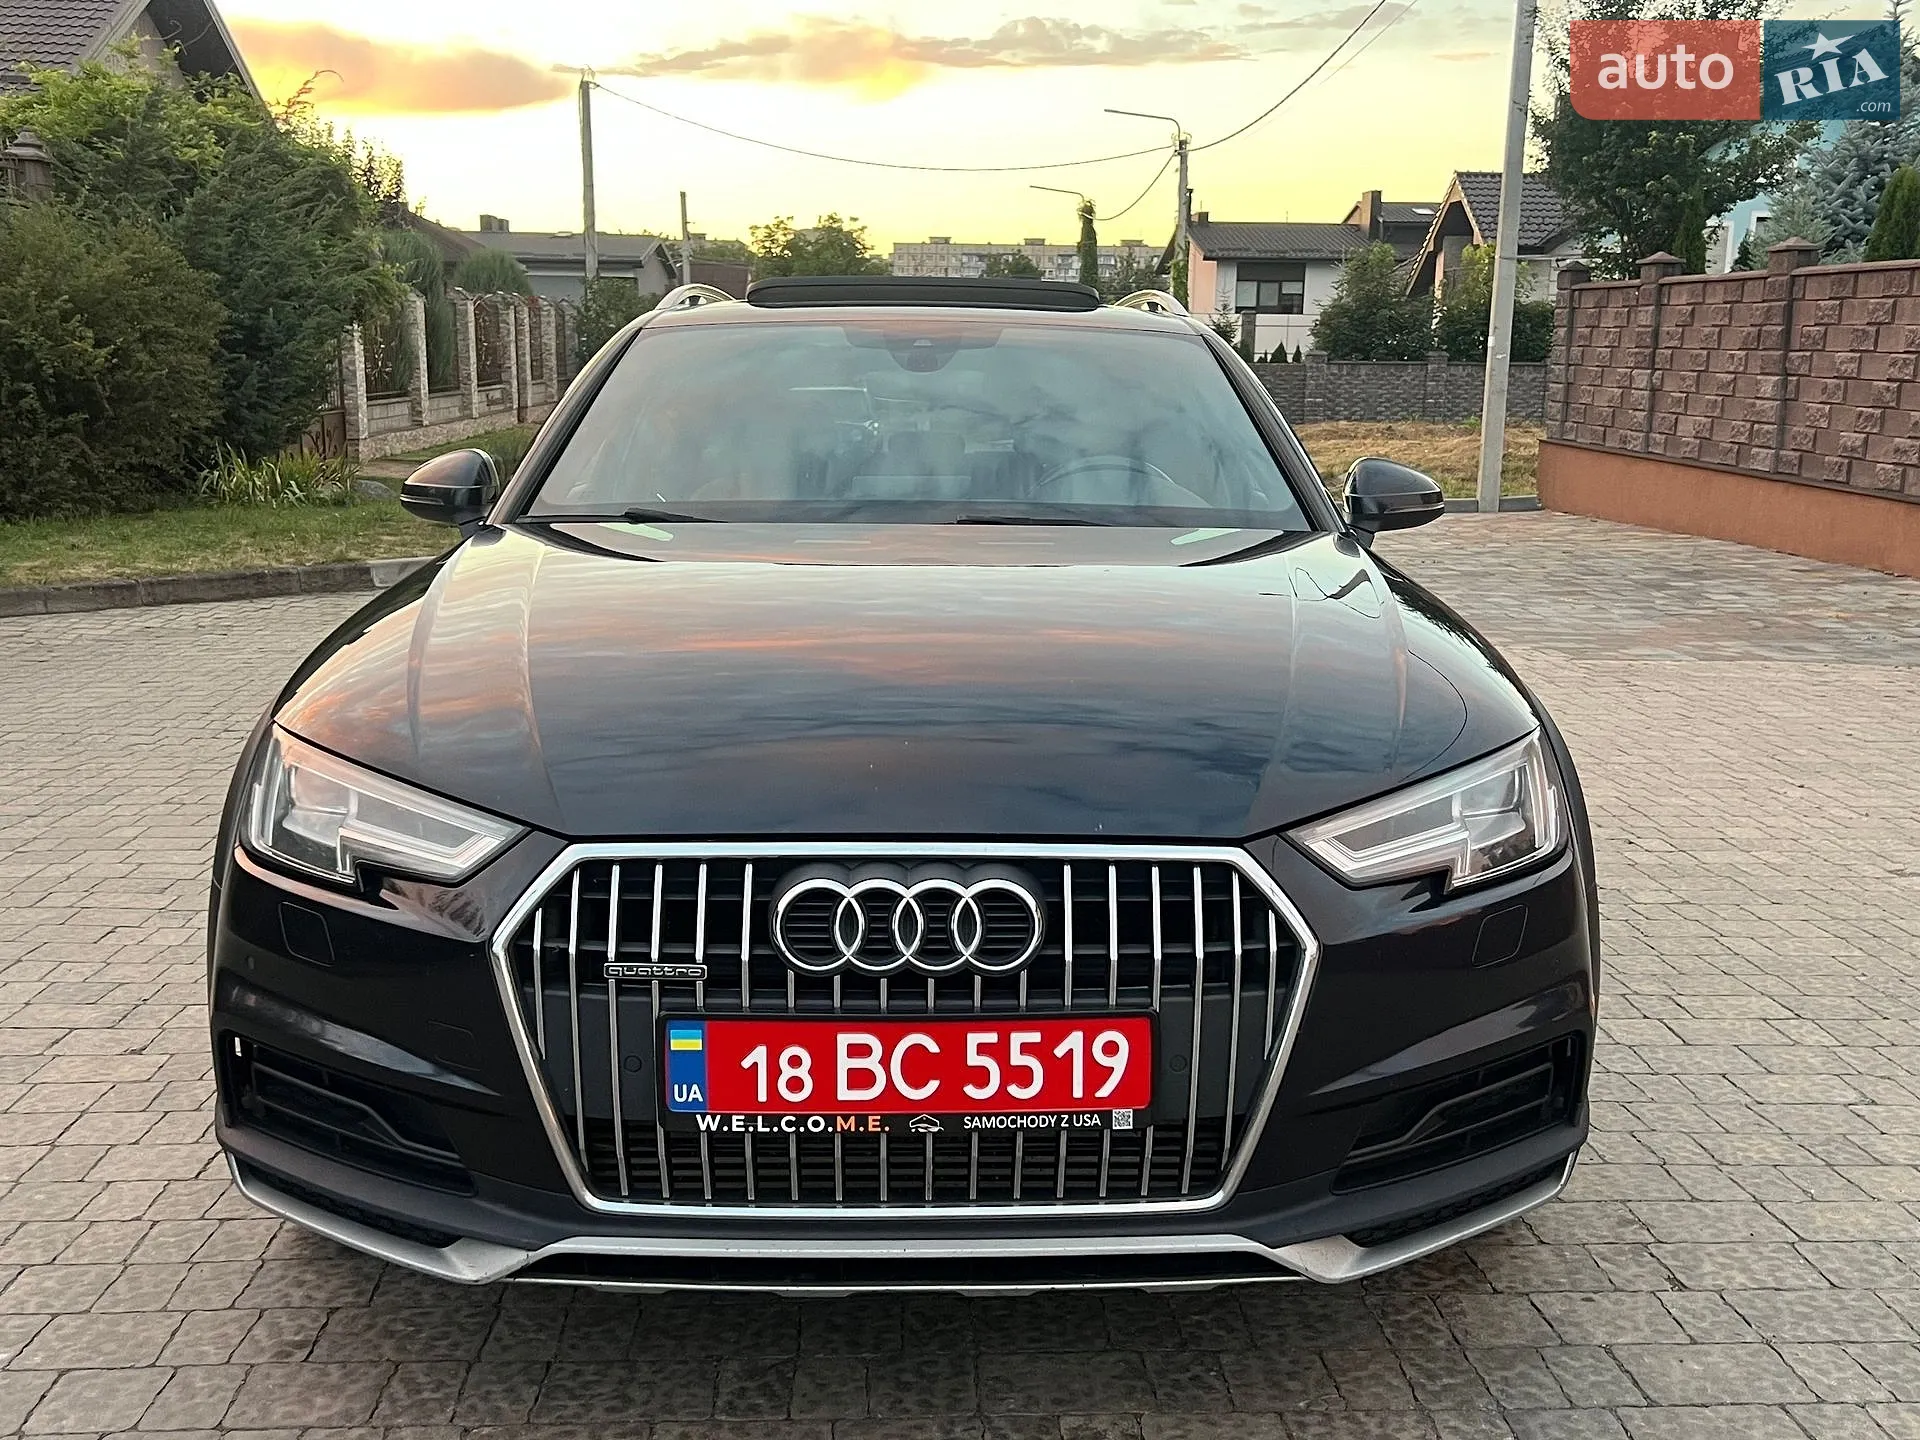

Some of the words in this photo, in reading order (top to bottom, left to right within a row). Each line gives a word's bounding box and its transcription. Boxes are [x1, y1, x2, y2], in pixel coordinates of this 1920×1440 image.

[608, 966, 702, 977] quattro
[740, 1044, 814, 1103] 18
[836, 1031, 941, 1101] BC
[962, 1030, 1130, 1100] 5519
[673, 1083, 704, 1103] UA
[695, 1113, 890, 1133] W.E.L.C.O.M.E.
[963, 1114, 1056, 1130] SAMOCHODY
[1060, 1114, 1069, 1128] Z
[1072, 1113, 1102, 1127] USA
